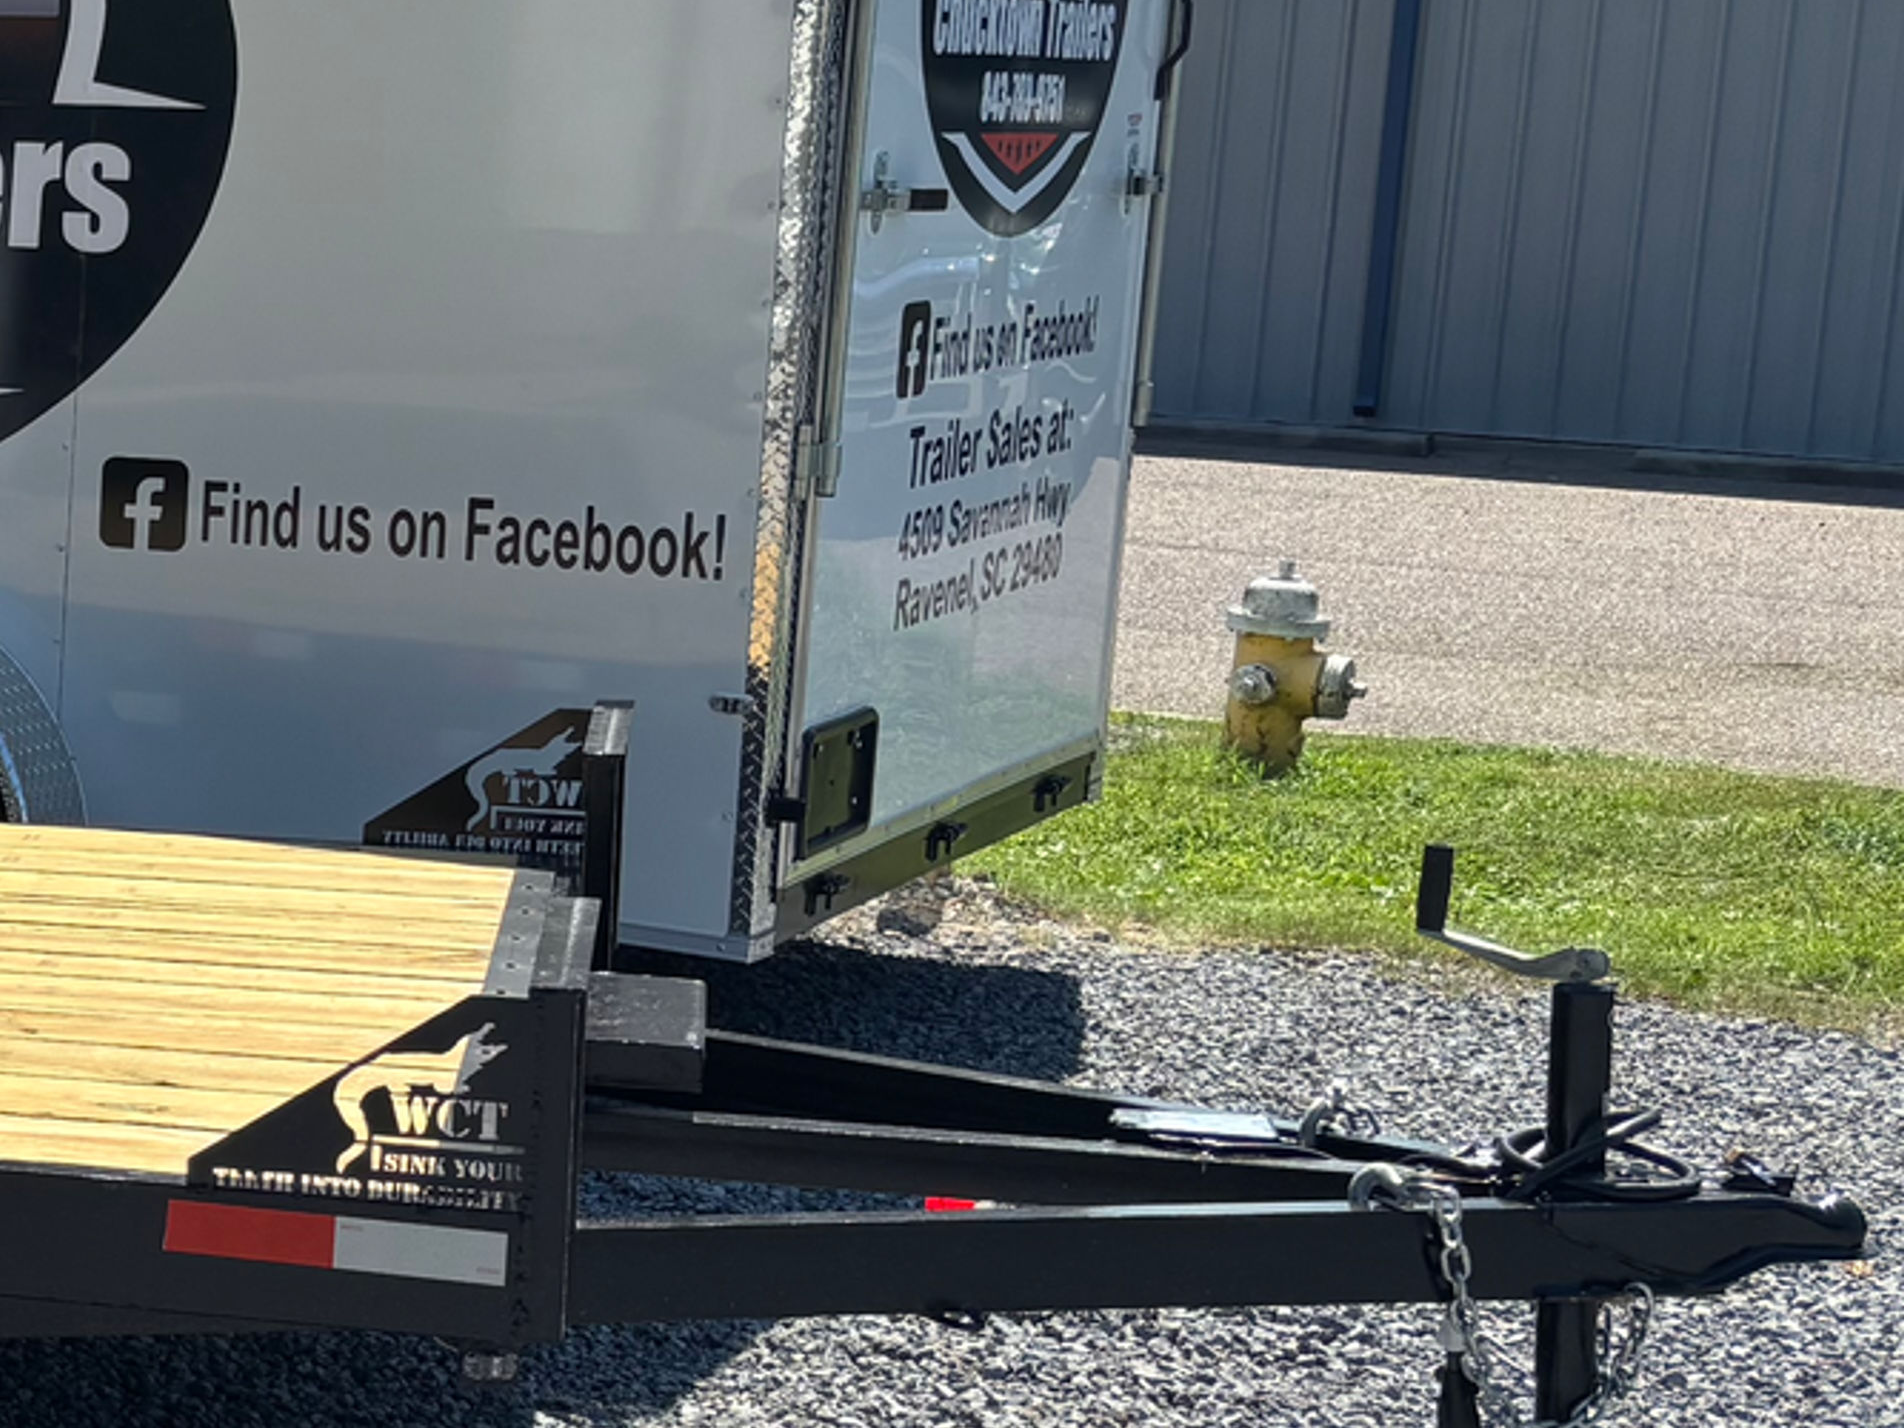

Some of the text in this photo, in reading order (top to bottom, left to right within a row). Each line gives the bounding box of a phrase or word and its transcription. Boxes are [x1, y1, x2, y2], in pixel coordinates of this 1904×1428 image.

[931, 314, 973, 380] Find
[974, 322, 995, 371] us
[996, 321, 1019, 366] on
[909, 400, 1074, 489] Trailer Sales at:
[201, 480, 300, 549] Find
[317, 503, 372, 555] us
[388, 505, 446, 559] on
[465, 496, 726, 581] Facebook!
[898, 479, 1072, 561] 4509 Savannah Hwy
[893, 533, 1063, 630] Ravenel, SC 29480
[390, 1093, 509, 1141] WCT
[300, 1172, 362, 1198] INTO
[453, 1158, 524, 1182] YOUR
